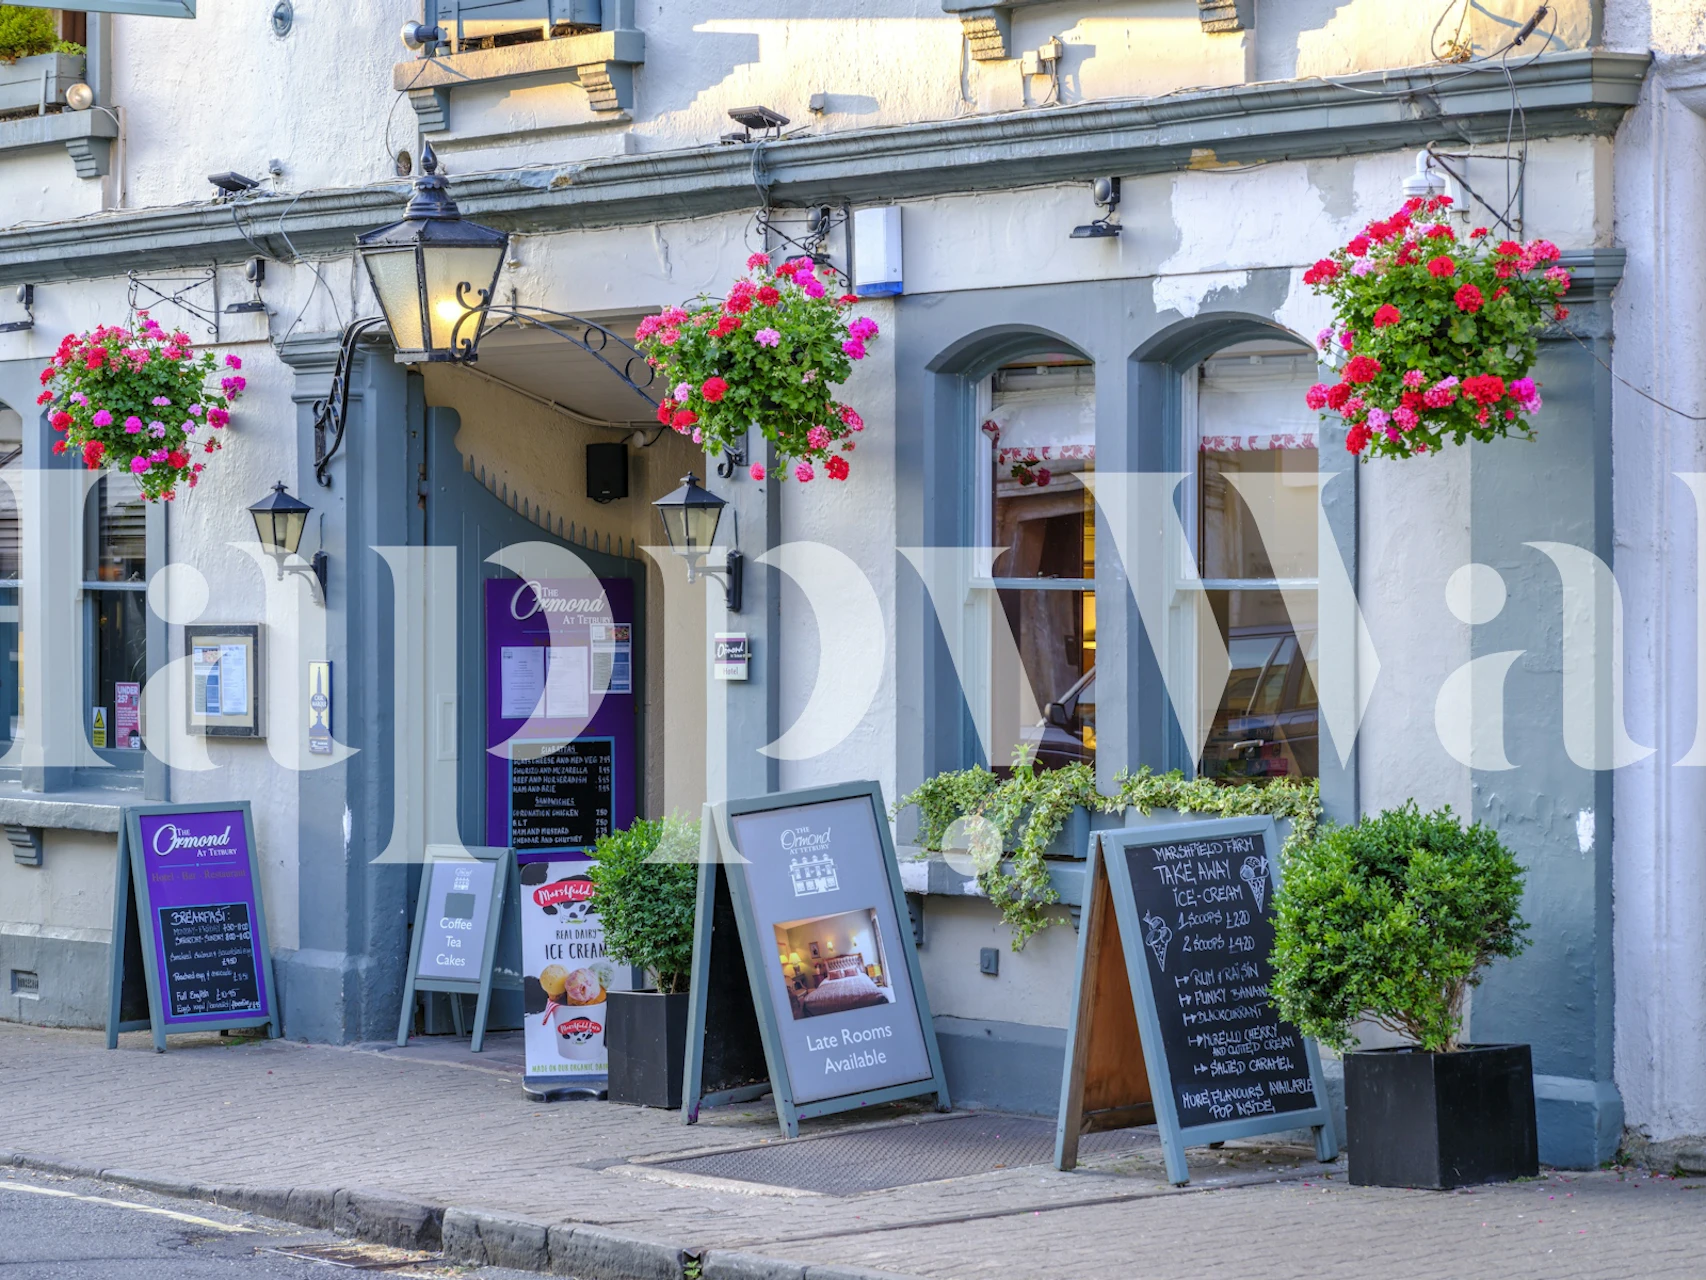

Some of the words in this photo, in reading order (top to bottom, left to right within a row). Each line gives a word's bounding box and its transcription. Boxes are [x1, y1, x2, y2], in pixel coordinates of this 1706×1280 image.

[510, 580, 606, 620] Ormond
[723, 667, 738, 675] Hotel
[117, 686, 138, 694] UNDER
[117, 695, 128, 703] 25?
[584, 756, 598, 764] VEG
[153, 823, 231, 856] Ormond
[780, 827, 831, 850] Ormond
[1152, 841, 1223, 861] MARSHFIELD
[1223, 837, 1254, 854] FARM
[151, 872, 174, 882] Hotel
[181, 871, 196, 880] Bar
[204, 868, 246, 879] Restaurant
[1153, 859, 1197, 885] TAKE
[1197, 859, 1231, 881] AWAY
[538, 884, 591, 905] Marshfield
[439, 917, 472, 930] Coffee
[446, 935, 462, 948] Tea
[556, 929, 573, 940] REAL
[575, 928, 597, 939] DAIRY
[545, 943, 564, 960] ICE
[569, 942, 608, 959] CREAM
[1182, 935, 1192, 952] 2
[436, 953, 466, 966] Cakes
[1190, 968, 1215, 986] RUM
[1222, 961, 1259, 982] RAISIN
[176, 991, 187, 1001] Full
[189, 989, 210, 1003] English
[1194, 988, 1226, 1006] FUNKY
[1230, 983, 1268, 1001] BANAN
[806, 1035, 838, 1052] Late
[841, 1025, 893, 1045] Rooms
[1244, 1023, 1278, 1043] CHERRY
[1264, 1035, 1295, 1050] CREAM
[825, 1049, 887, 1075] Available
[1210, 1059, 1246, 1077] SALTED
[1249, 1056, 1294, 1071] CARAMEL
[1182, 1088, 1211, 1109] MORE
[1211, 1083, 1264, 1104] FLAVOURS
[1269, 1076, 1314, 1097] AVAILABLE
[1209, 1104, 1234, 1119] POP
